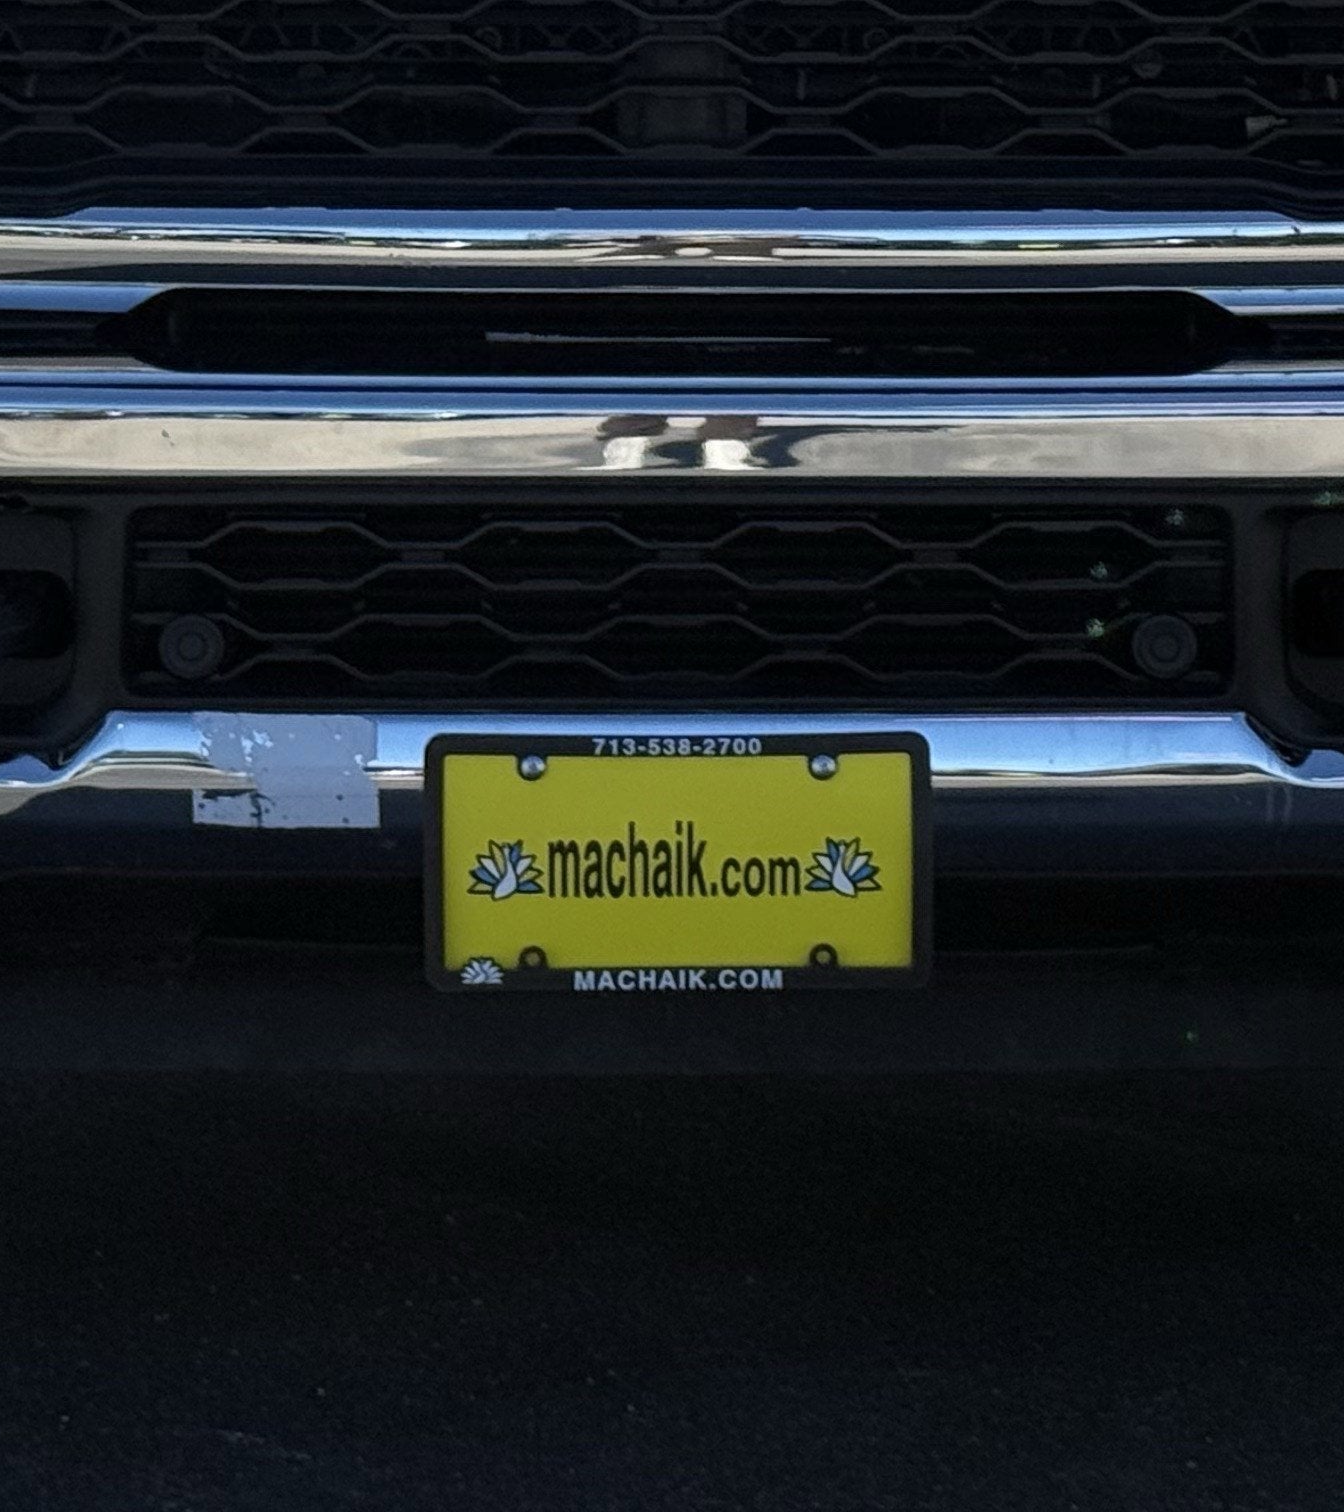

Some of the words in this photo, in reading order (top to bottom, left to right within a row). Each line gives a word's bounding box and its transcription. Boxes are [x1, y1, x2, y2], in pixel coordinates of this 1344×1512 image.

[592, 738, 762, 756] 713-538-2700
[549, 820, 802, 898] machaik.com
[573, 970, 783, 991] MACHAIK.COM
